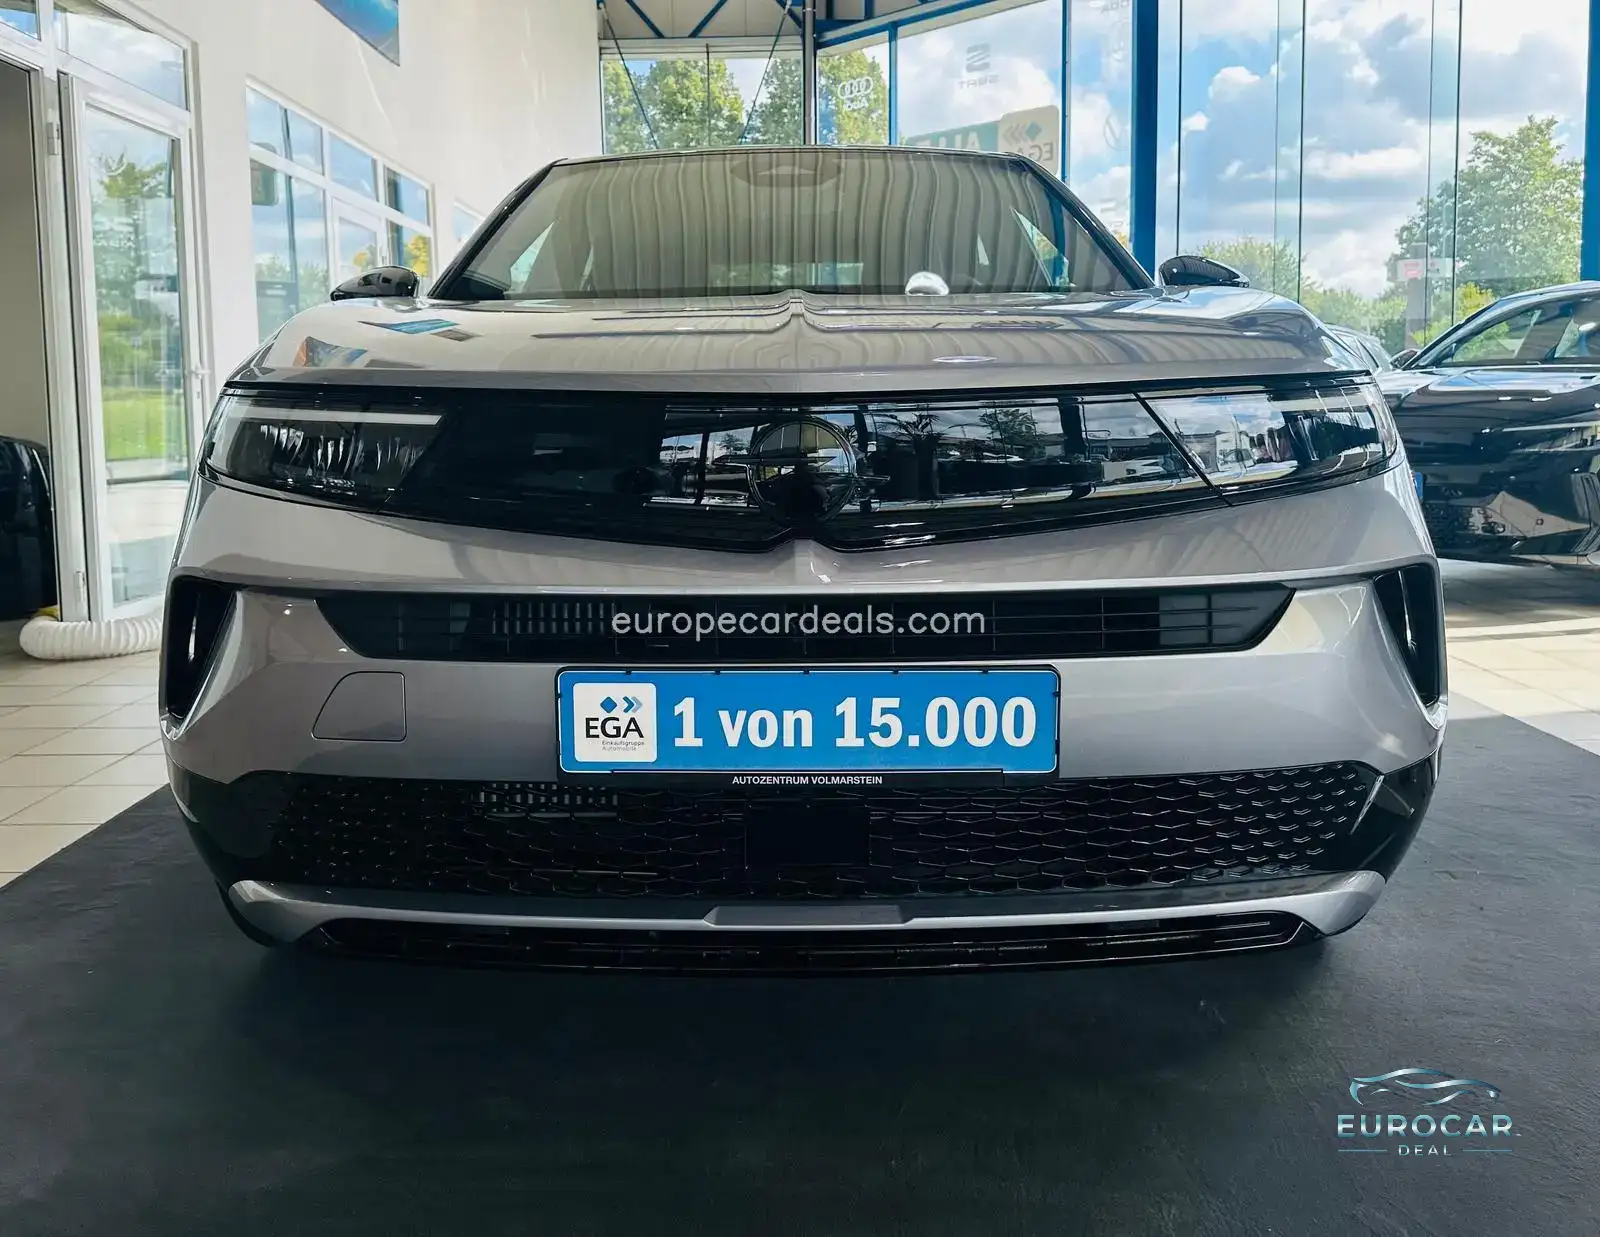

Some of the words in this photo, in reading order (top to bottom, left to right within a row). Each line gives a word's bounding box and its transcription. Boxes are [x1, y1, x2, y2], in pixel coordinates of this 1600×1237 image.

[585, 716, 645, 739] EGA
[673, 697, 704, 747] 1
[719, 708, 813, 748] von
[834, 697, 1036, 747] 15.000
[732, 776, 809, 785] AUTOZENTRUM
[811, 776, 883, 785] VOLMARSTEIN
